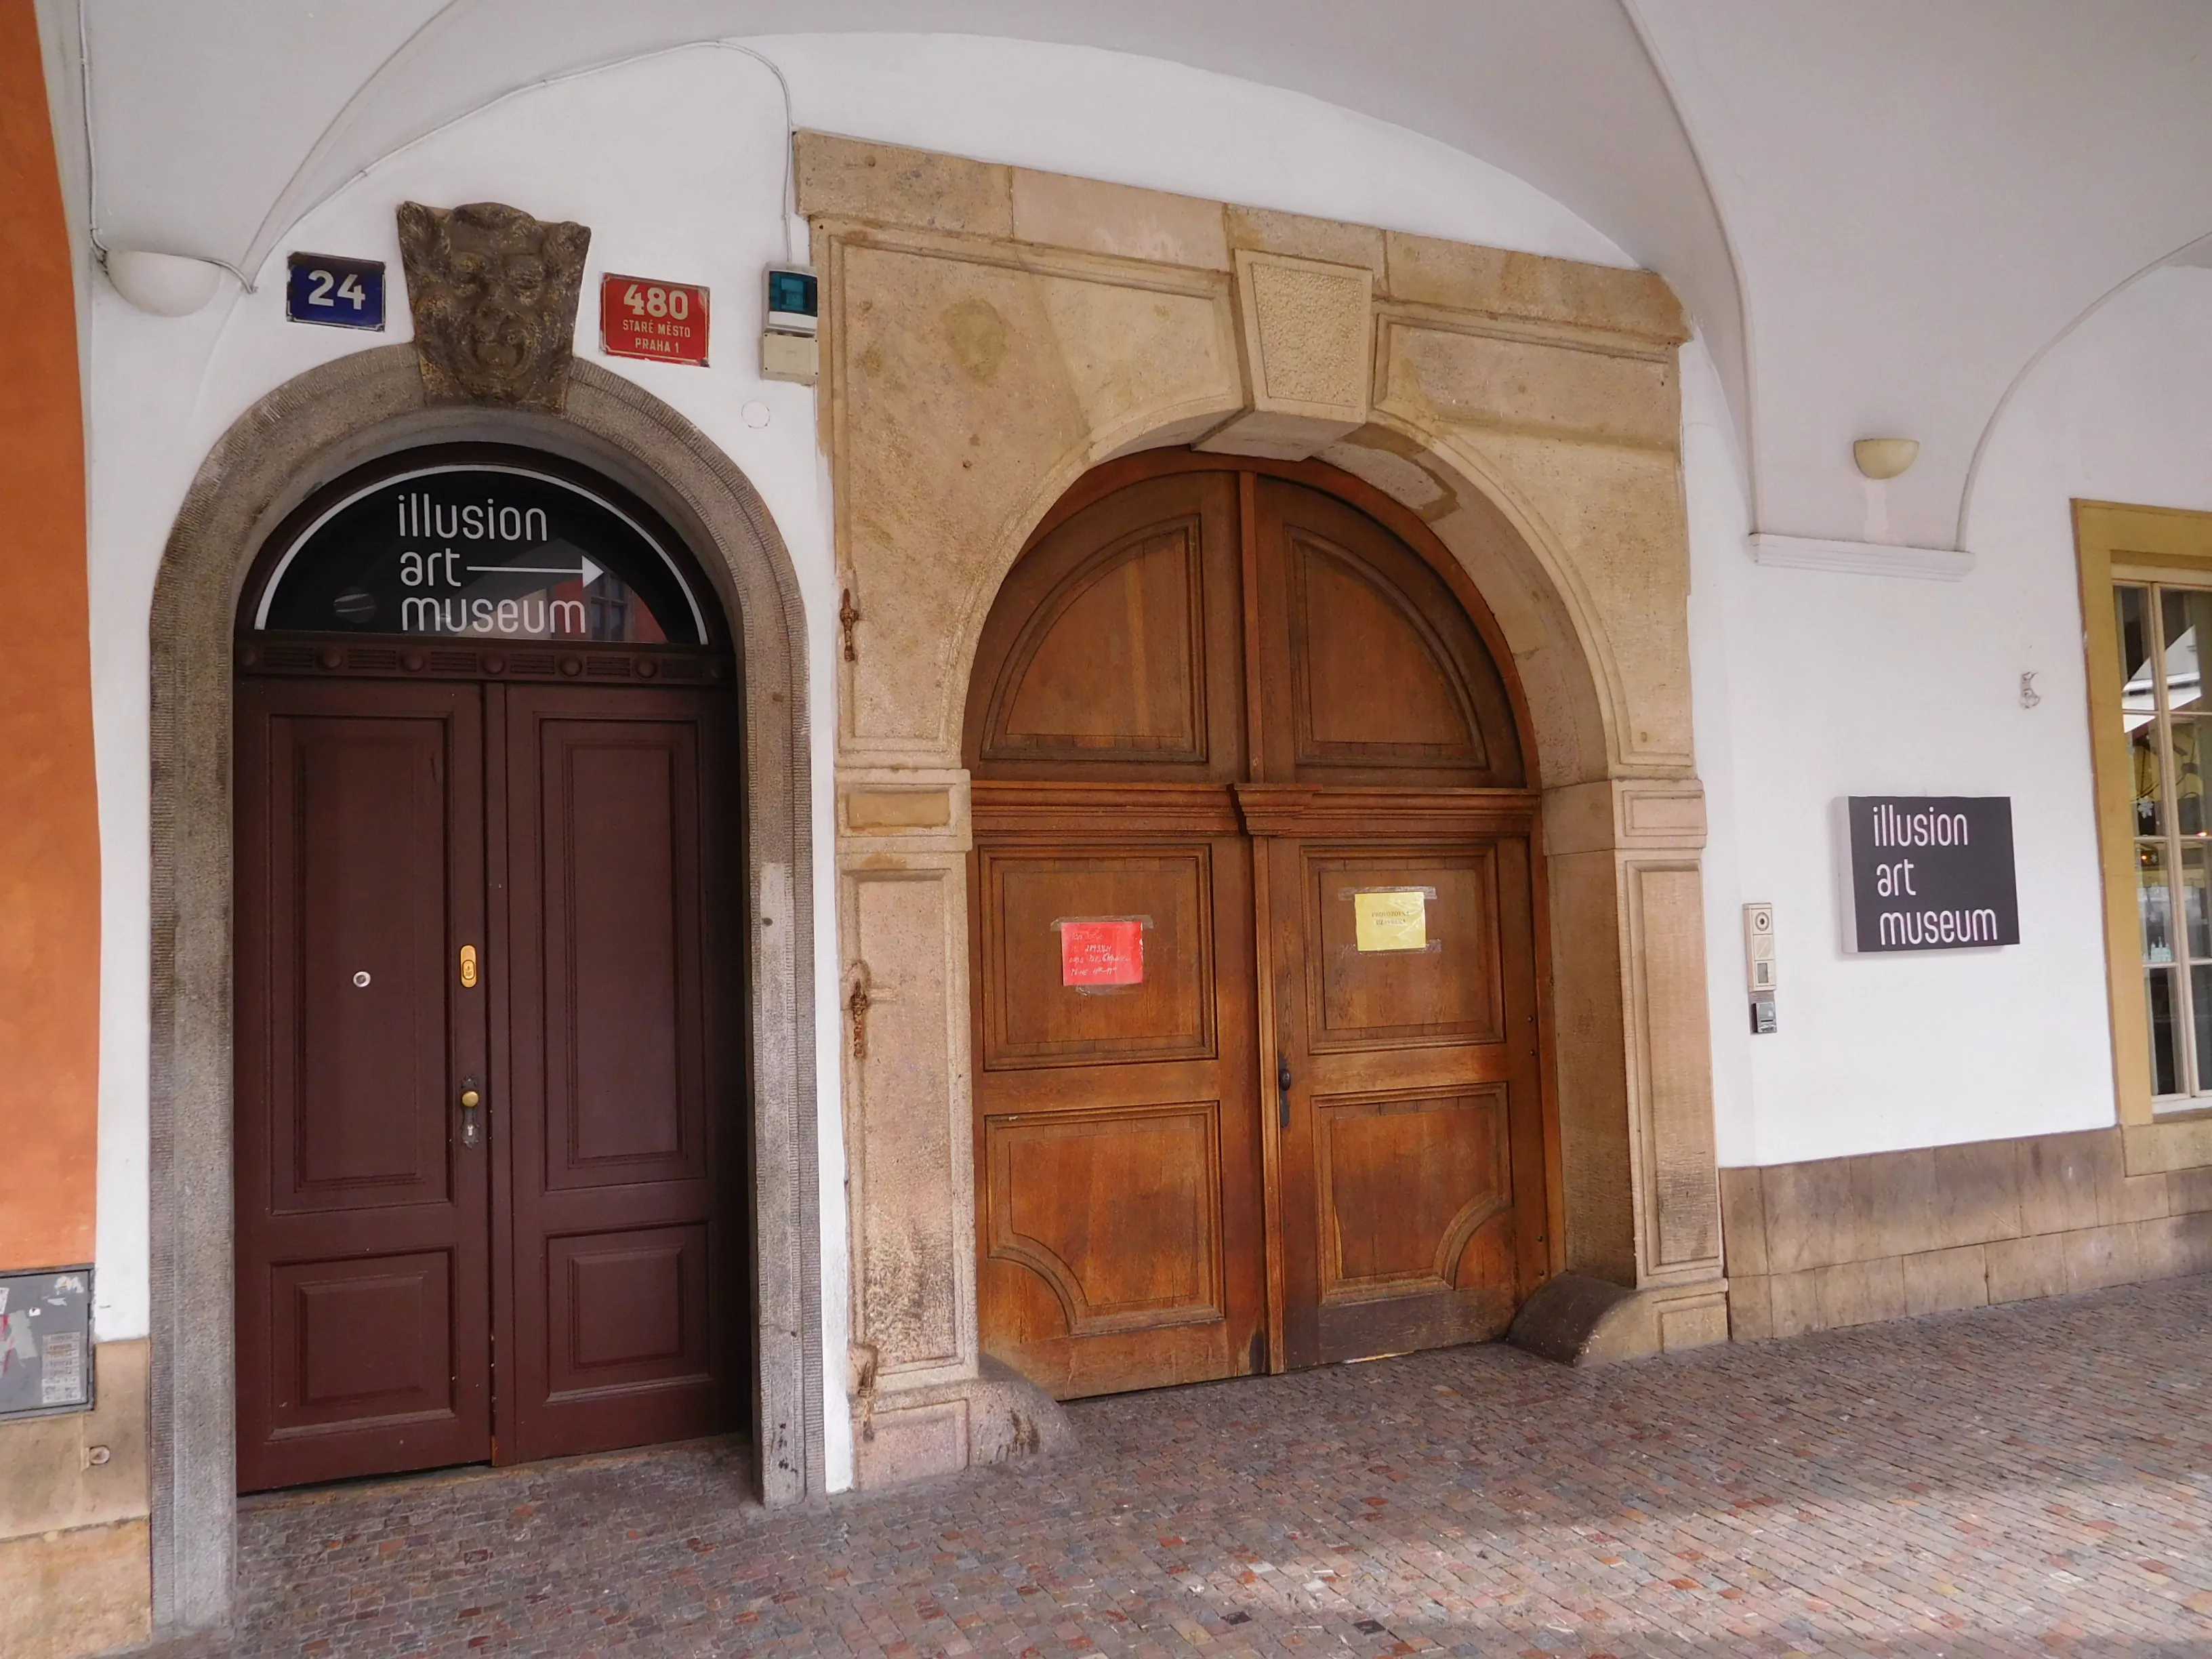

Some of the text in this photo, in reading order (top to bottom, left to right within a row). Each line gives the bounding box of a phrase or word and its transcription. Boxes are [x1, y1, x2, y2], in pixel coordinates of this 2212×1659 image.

[308, 270, 366, 310] 24
[623, 284, 688, 320] 480
[623, 319, 691, 338] STARÉ MĚSTO
[635, 337, 680, 354] PRAHA 1
[398, 493, 548, 541] illusion
[400, 548, 462, 587] art
[401, 597, 586, 634] museum
[1873, 804, 1968, 846] illusion
[1877, 859, 1917, 897] art
[1879, 908, 1998, 946] museum
